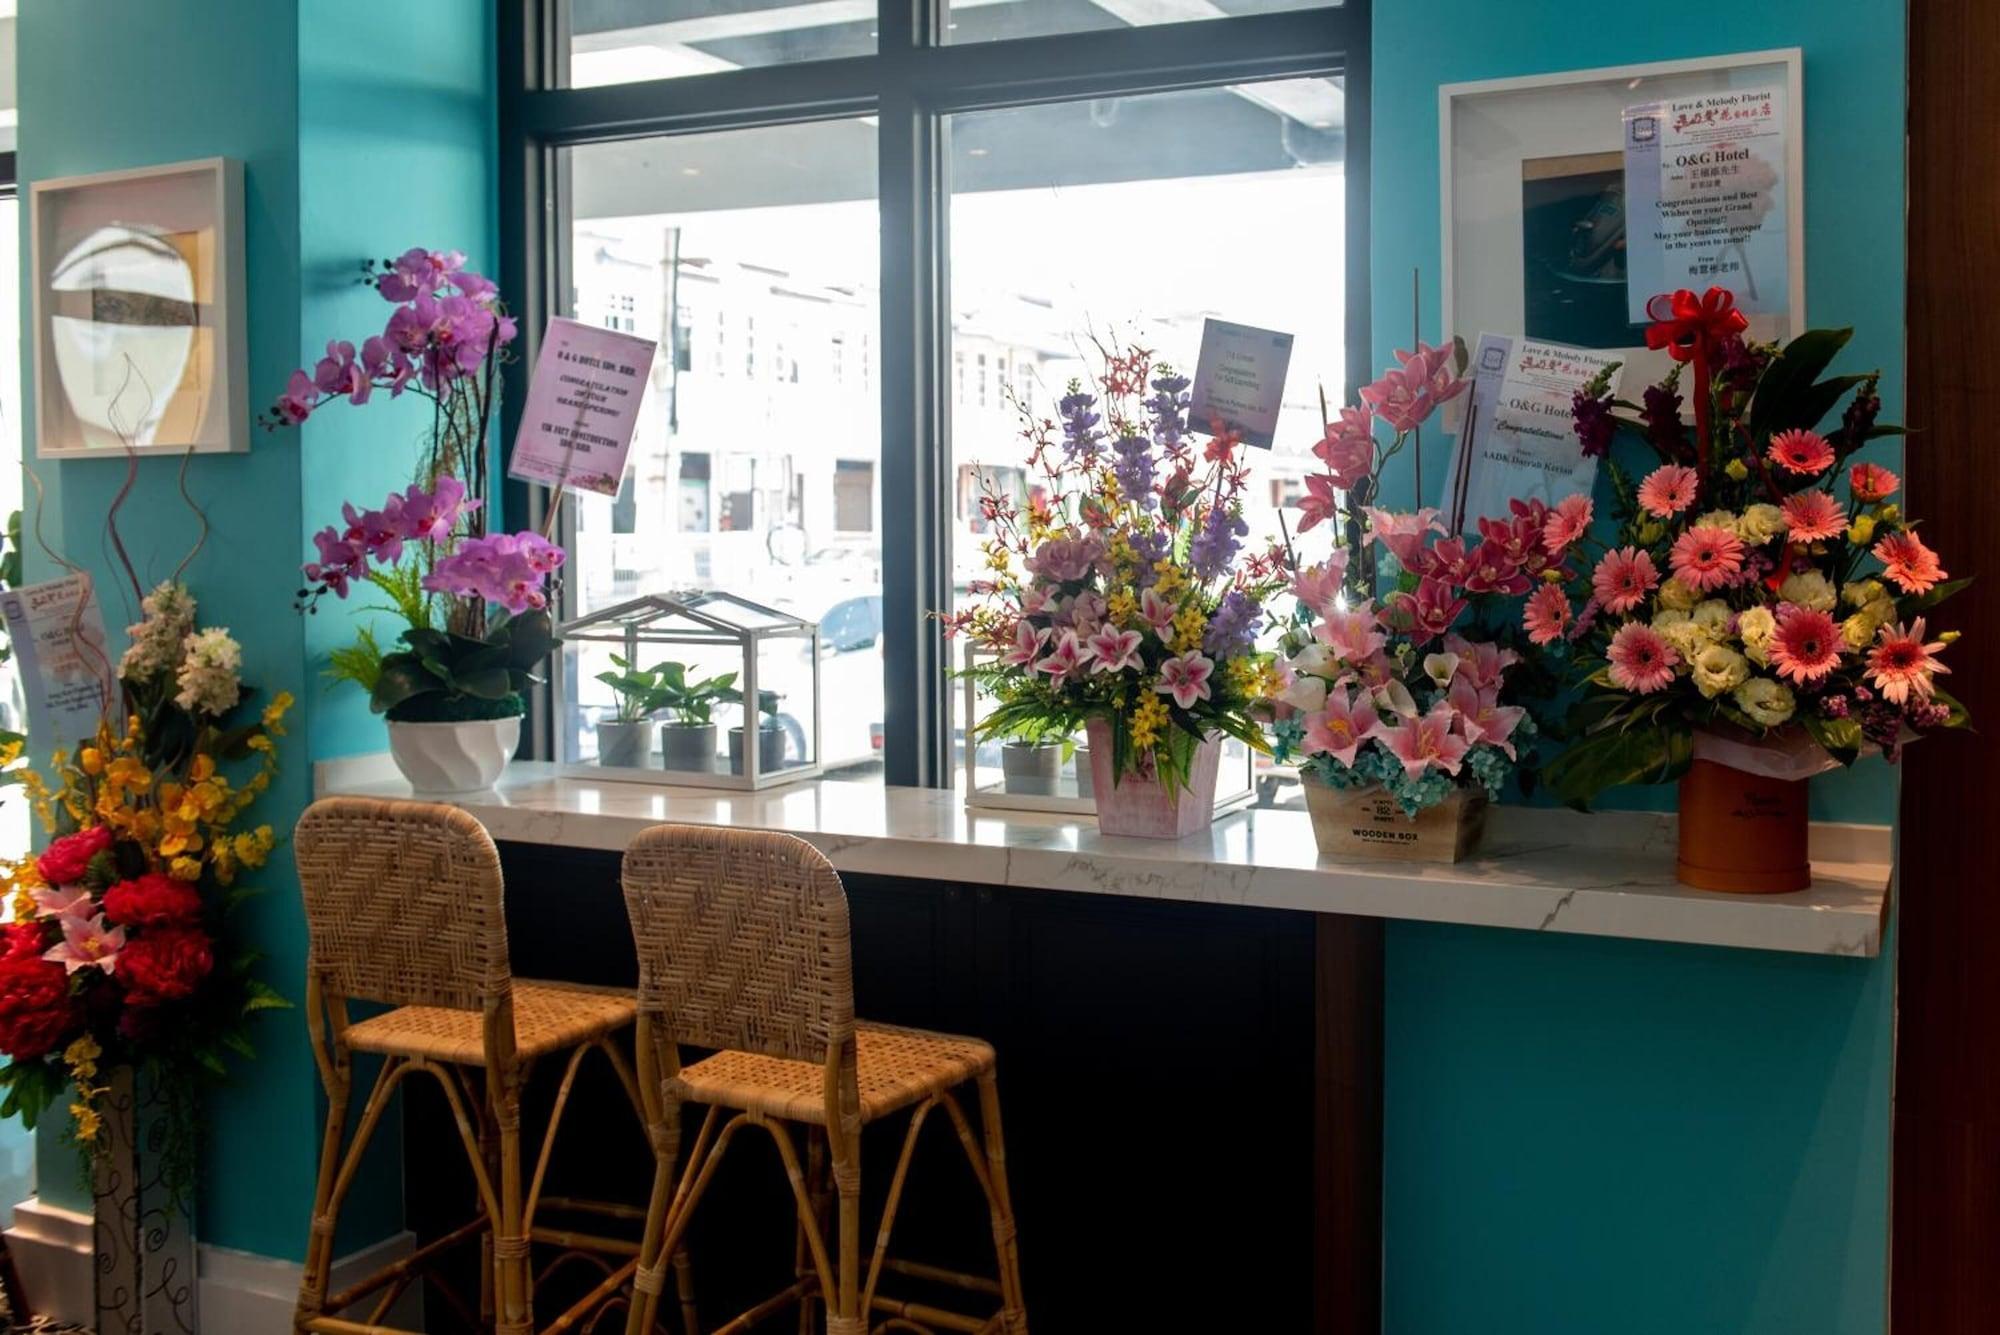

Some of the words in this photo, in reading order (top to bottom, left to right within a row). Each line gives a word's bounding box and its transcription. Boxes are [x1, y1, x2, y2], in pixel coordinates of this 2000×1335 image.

[1672, 102, 1693, 113] Love
[1695, 100, 1703, 108] &
[1706, 95, 1739, 107] Melody
[1742, 92, 1771, 103] Florist
[1676, 152, 1711, 167] O&G
[1715, 148, 1749, 162] Hotel
[1655, 194, 1720, 209] Congratulations
[1723, 191, 1738, 201] and
[1740, 190, 1758, 200] Best
[1661, 208, 1690, 219] Wishes
[1704, 205, 1722, 215] your
[1724, 202, 1752, 212] Grand
[1654, 231, 1671, 242] May
[1673, 230, 1692, 240] your
[1694, 226, 1728, 237] business
[1730, 223, 1763, 235] prosper
[1665, 241, 1673, 251] in
[1675, 239, 1687, 249] the
[1689, 240, 1712, 250] years
[1713, 237, 1722, 245] to
[1522, 344, 1542, 356] Love
[1543, 348, 1552, 356] &
[1553, 349, 1582, 361] Melody
[1510, 398, 1540, 413] O&G
[1352, 828, 1396, 840] WOODEN
[1398, 831, 1418, 841] BOX
